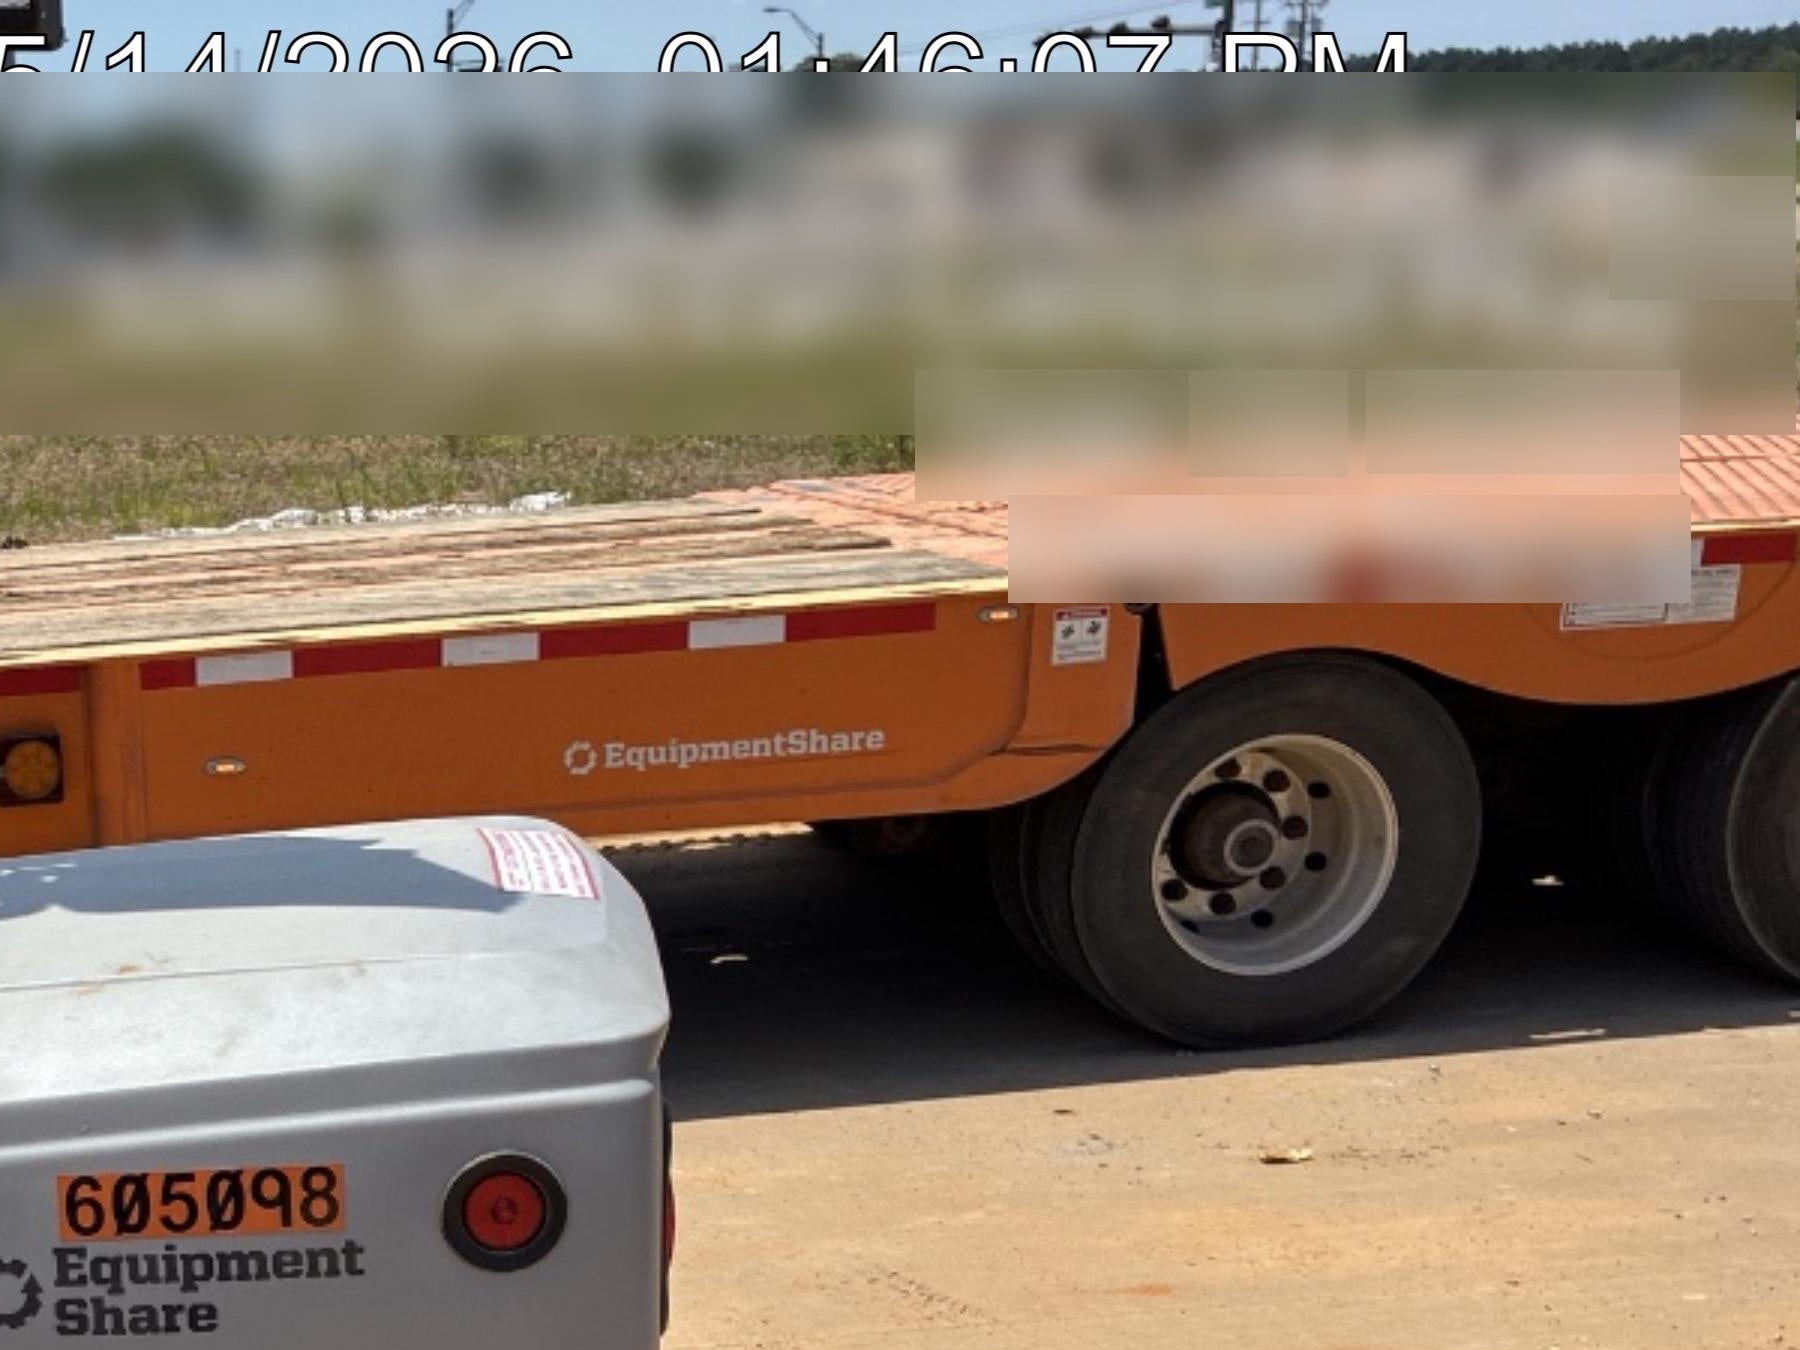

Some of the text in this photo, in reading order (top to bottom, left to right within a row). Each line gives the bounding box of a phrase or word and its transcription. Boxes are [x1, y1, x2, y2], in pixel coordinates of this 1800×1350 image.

[603, 728, 885, 771] EquipmentShare
[65, 1166, 340, 1237] 605098
[53, 1239, 365, 1295] Equipment
[55, 1297, 219, 1336] Share
